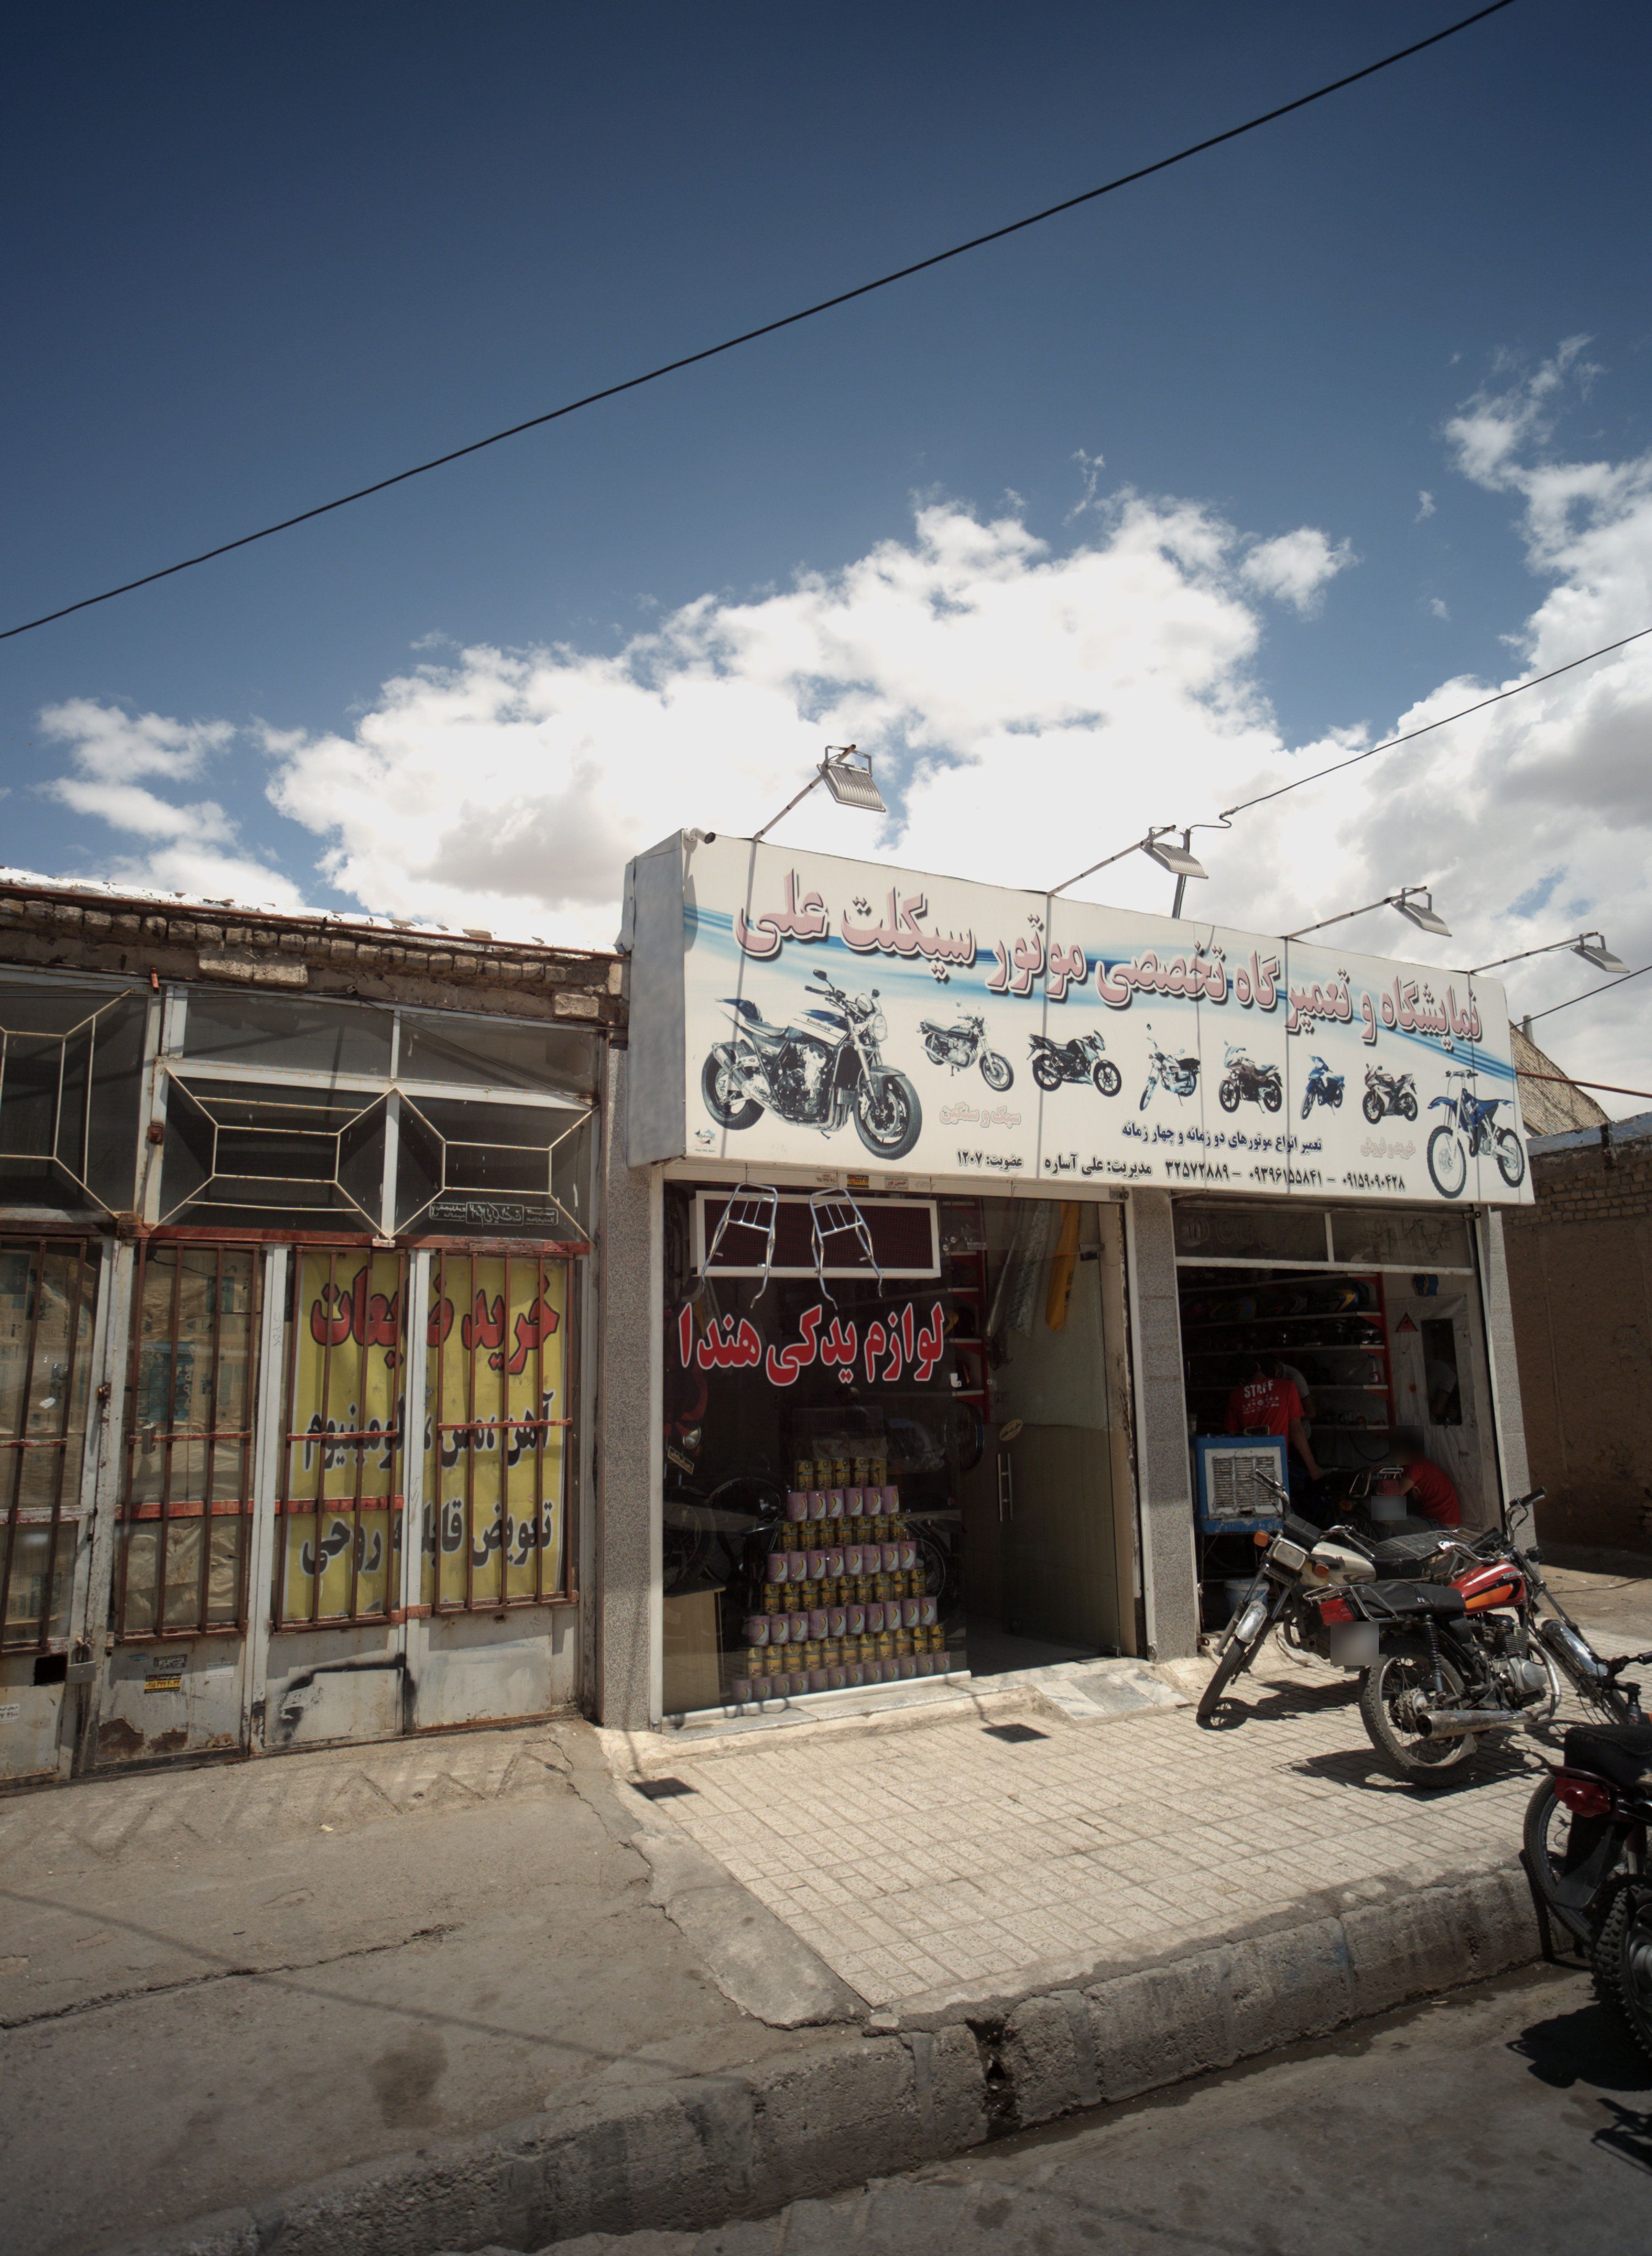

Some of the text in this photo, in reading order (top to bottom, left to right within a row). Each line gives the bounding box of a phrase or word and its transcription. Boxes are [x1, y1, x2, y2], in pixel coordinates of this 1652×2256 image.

[734, 869, 829, 957] علی
[841, 887, 976, 983] سیکلت
[985, 914, 1088, 1002] موتور
[1096, 940, 1229, 1010] تخصصی
[1361, 991, 1376, 1046] و
[1381, 975, 1482, 1053] نمایشگاه
[939, 1102, 1021, 1129] سبک و سنگین
[1121, 1120, 1148, 1143] زمانه
[1151, 1122, 1175, 1146] چهار
[1177, 1132, 1184, 1145] و
[1186, 1126, 1211, 1147] زمانه
[1214, 1132, 1225, 1148] دو
[1275, 1134, 1297, 1154] انواع
[1301, 1137, 1323, 1156] تعمیر
[1361, 1137, 1416, 1159] خرید و فروش
[957, 1149, 1024, 1172] عضویت: ۱۲۰۷
[1044, 1152, 1153, 1179] مدیریت: علی آساره
[1165, 1158, 1230, 1181] ۳۲۵۷۲۸۸۹
[310, 1265, 560, 1375] خرید ضیعات
[678, 1301, 945, 1386] لوازم یدکی هندا
[1243, 1380, 1274, 1398] STAFF
